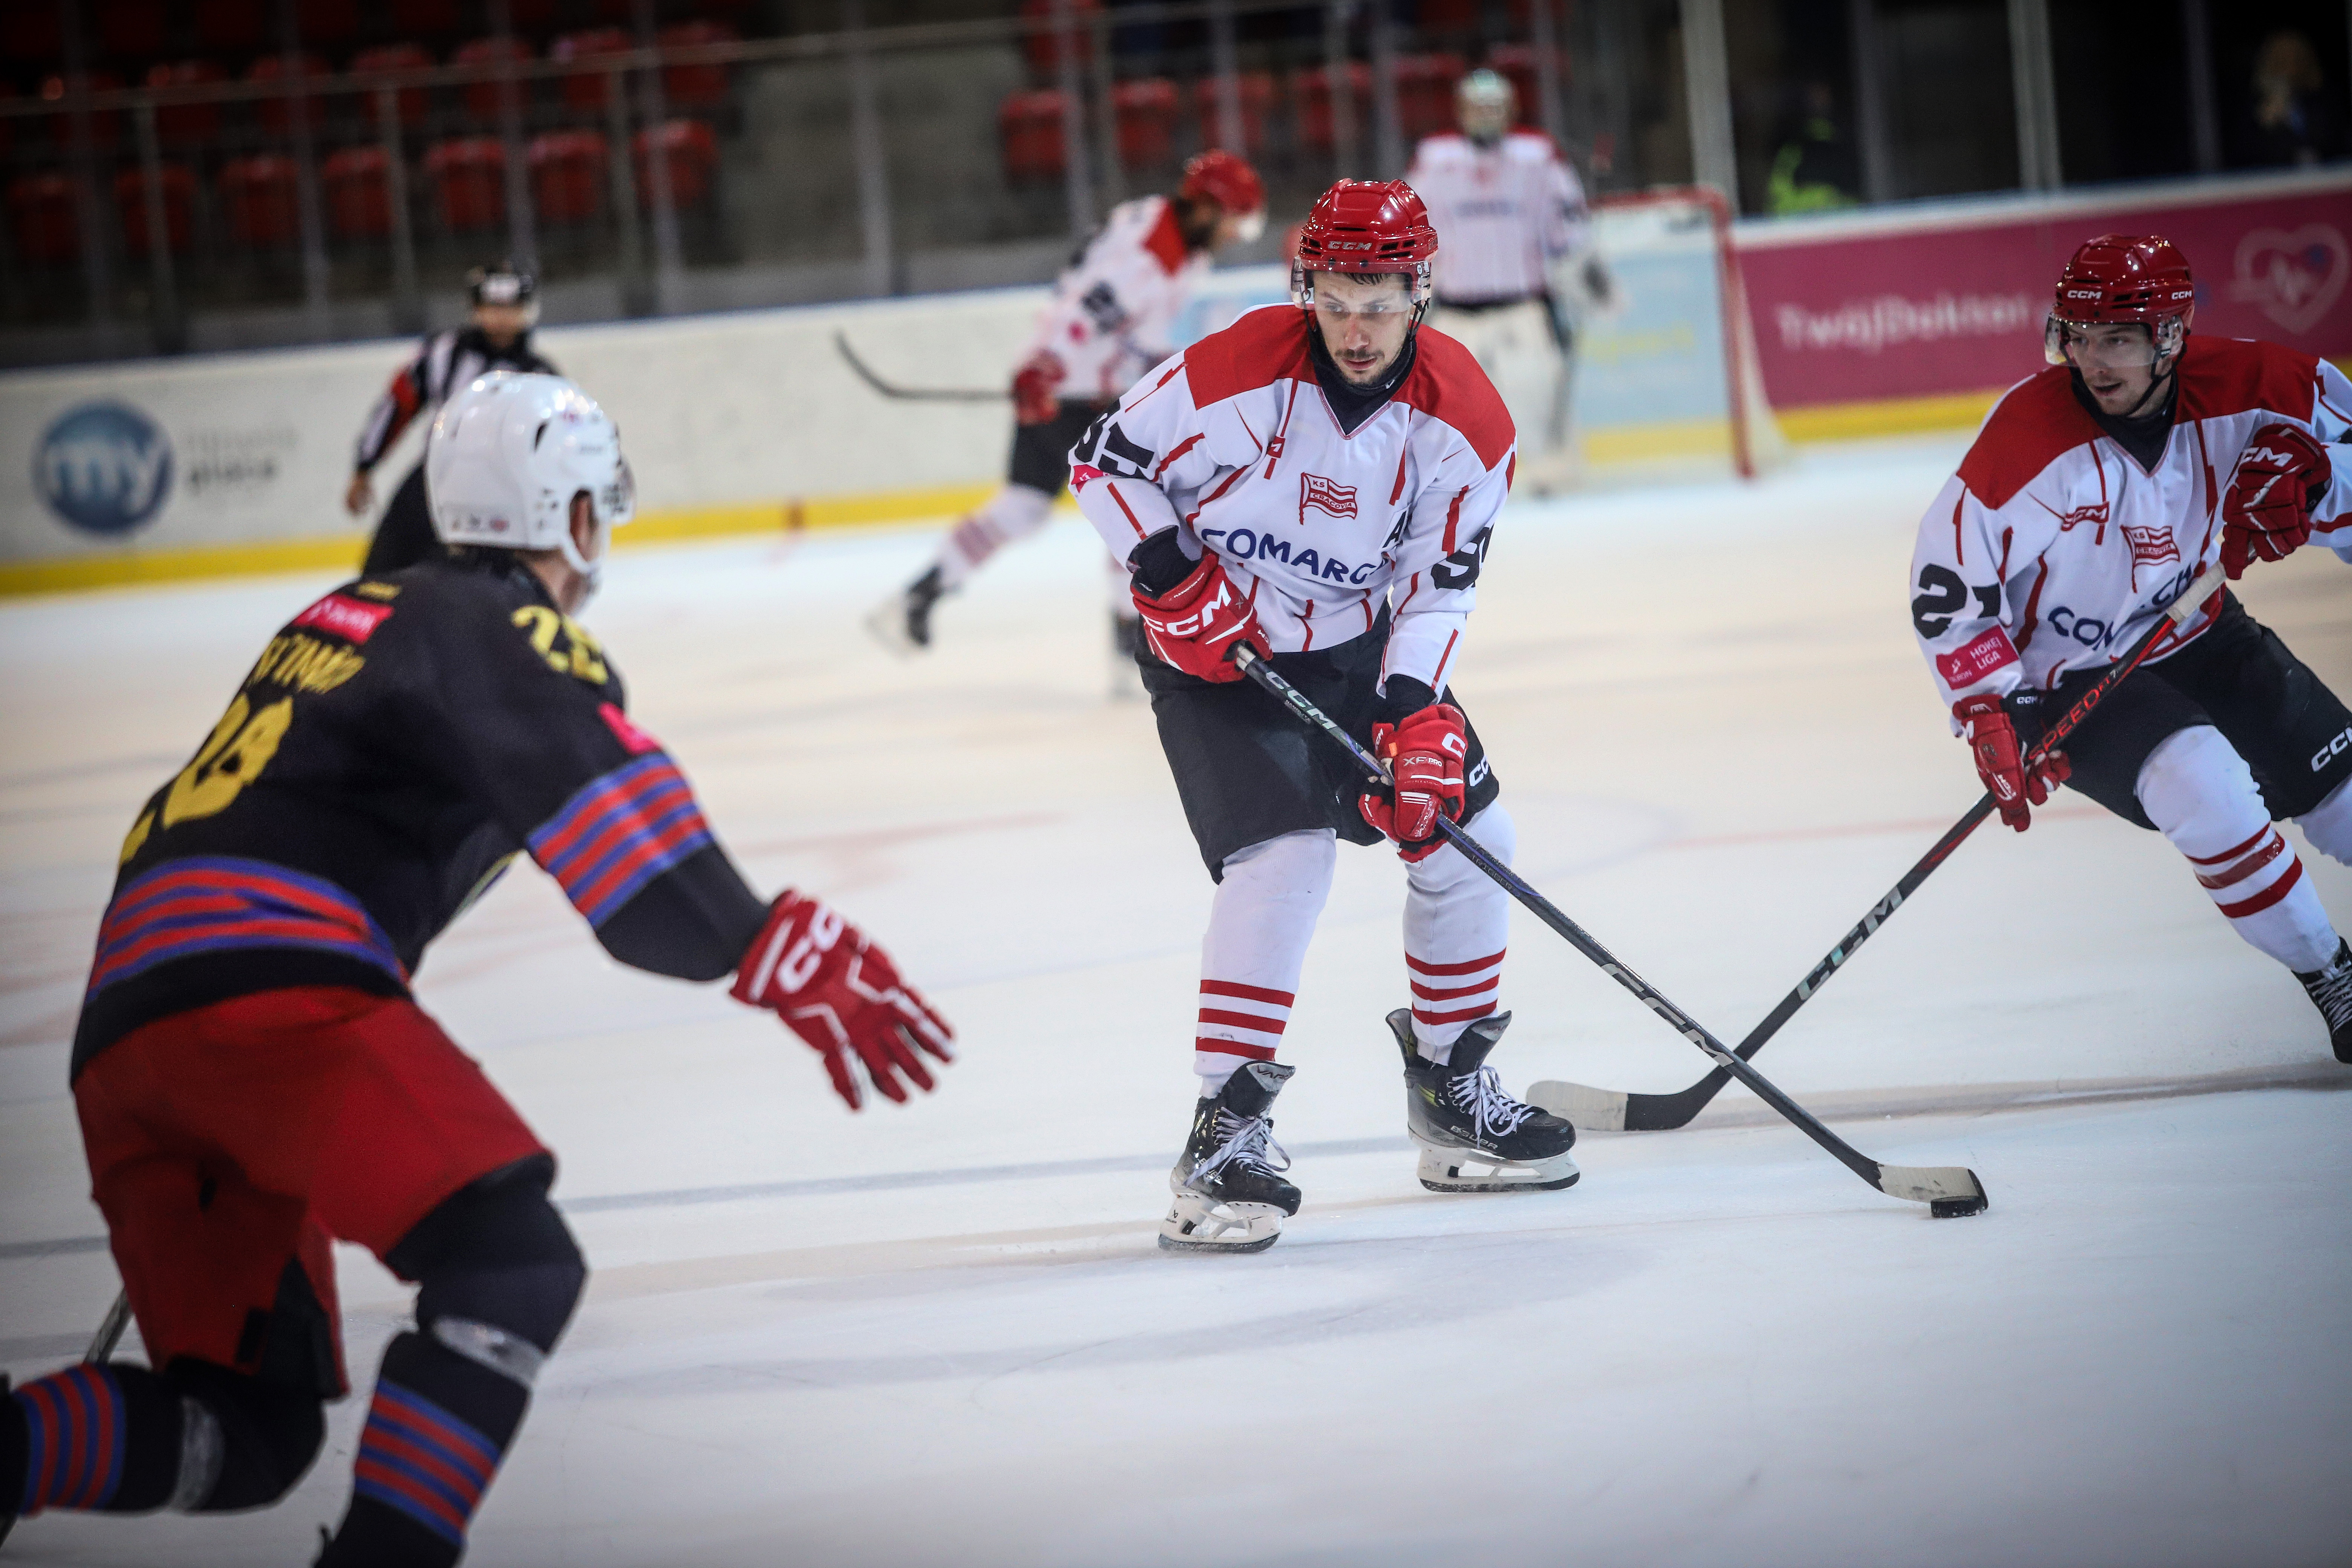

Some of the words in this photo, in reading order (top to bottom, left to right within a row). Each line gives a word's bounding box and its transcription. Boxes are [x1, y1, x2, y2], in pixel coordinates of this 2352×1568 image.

[1328, 240, 1372, 250] CCM
[2067, 290, 2102, 299] CCM
[2171, 291, 2192, 300] CCM
[1313, 493, 1352, 508] CRACOVIA
[1383, 511, 1407, 548] A
[1976, 651, 2001, 670] LIGA
[1265, 671, 1338, 730] CCM
[1403, 756, 1427, 767] XF
[1428, 757, 1443, 767] PRO
[1469, 755, 1489, 787] CC
[778, 905, 845, 993] CC
[1796, 884, 1903, 1001] CCM
[1600, 963, 1734, 1067] CCM
